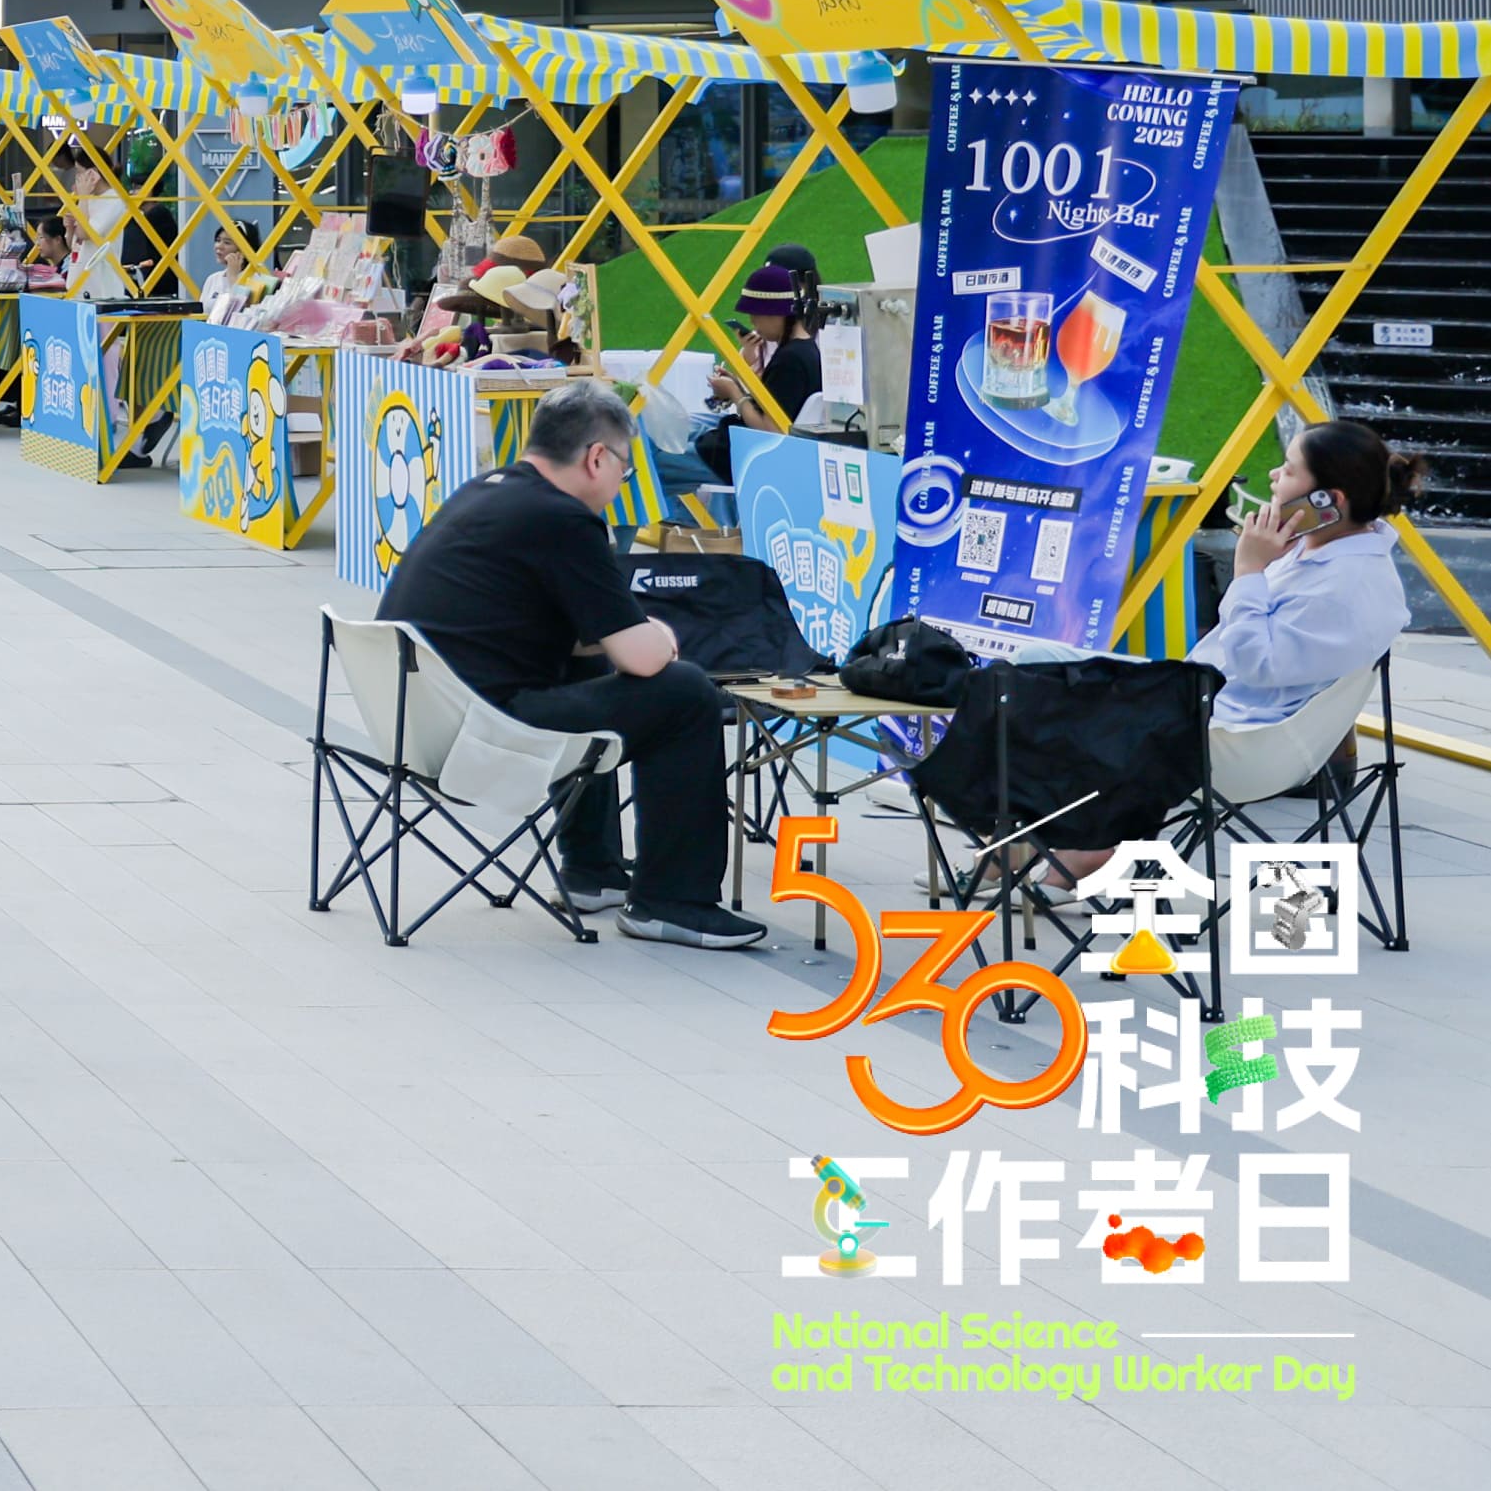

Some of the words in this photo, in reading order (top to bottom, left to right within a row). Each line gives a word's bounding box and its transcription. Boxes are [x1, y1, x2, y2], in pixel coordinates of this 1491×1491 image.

[951, 65, 961, 89] BAR
[1123, 84, 1193, 107] HELLO
[946, 100, 960, 152] COFFEE
[1107, 104, 1189, 127] COMING
[1192, 117, 1212, 170] COFFEE
[1206, 80, 1222, 106] BAR
[1133, 126, 1184, 148] 2025
[965, 139, 1115, 200] 1001
[942, 189, 952, 215] BAR
[1047, 200, 1110, 231] Nights
[1114, 205, 1160, 229] Bar
[936, 226, 950, 277] COFFEE
[1163, 244, 1183, 299] COFFEE
[1177, 207, 1192, 234] BAR
[933, 315, 943, 341] BAR
[927, 352, 941, 404] COFFEE
[1135, 374, 1153, 429] COFFEE
[1149, 337, 1164, 363] BAR
[1104, 502, 1123, 559] COFFEE
[1118, 466, 1135, 493] BAR
[654, 575, 698, 588] EUSSUE
